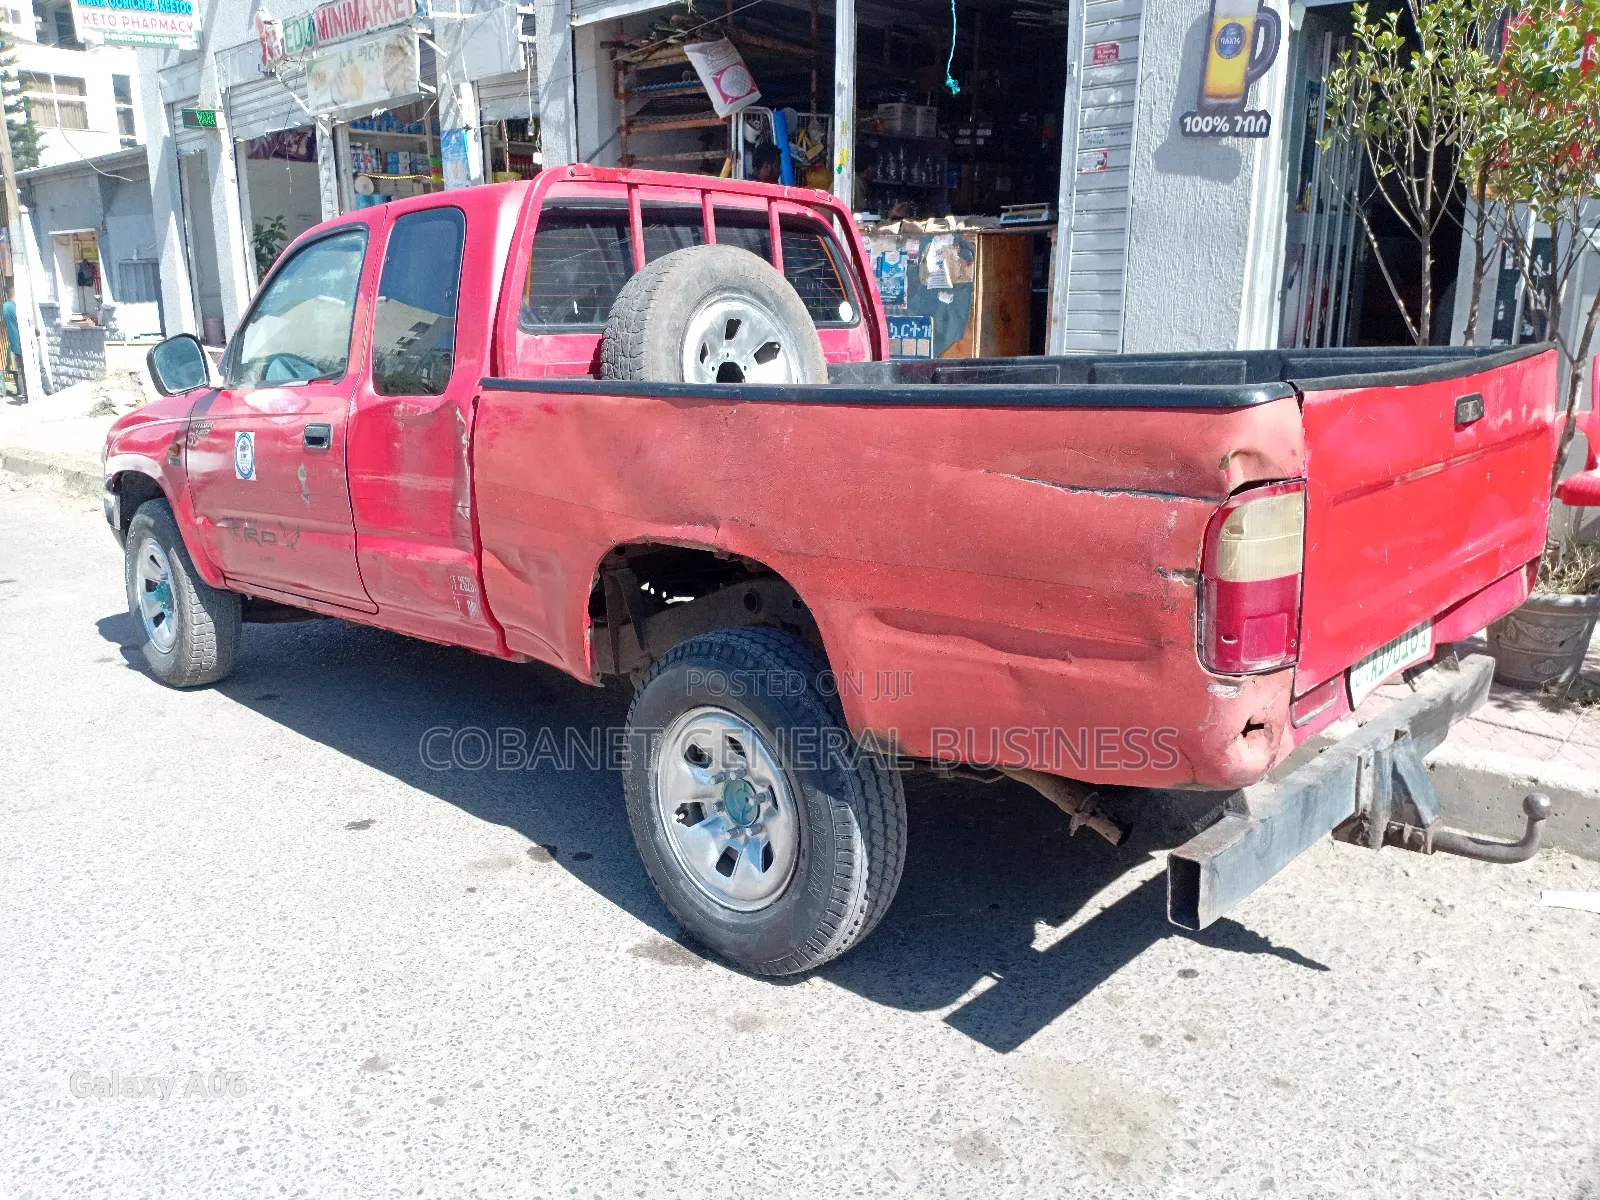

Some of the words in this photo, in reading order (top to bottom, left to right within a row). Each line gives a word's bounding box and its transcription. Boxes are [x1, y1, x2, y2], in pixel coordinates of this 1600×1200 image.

[82, 11, 117, 27] KETO
[121, 15, 194, 33] PHARMACY
[1183, 115, 1230, 133] 100%
